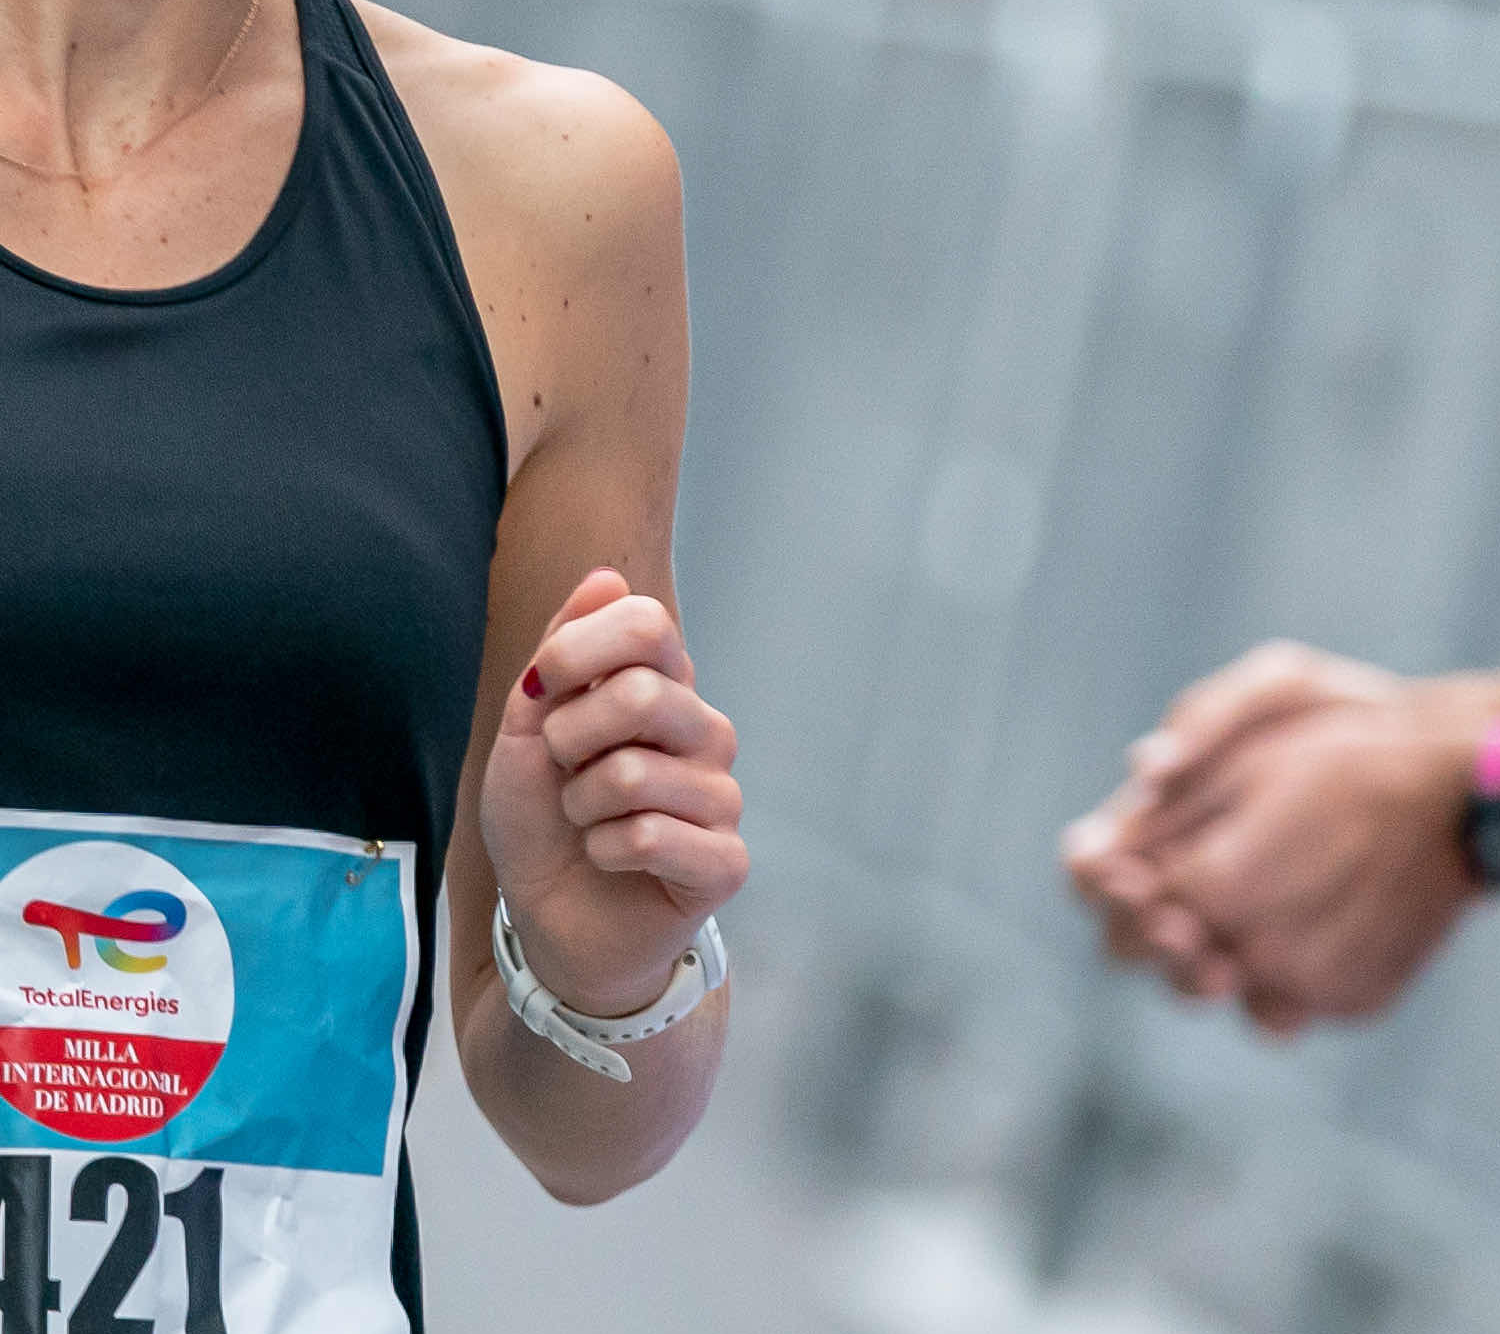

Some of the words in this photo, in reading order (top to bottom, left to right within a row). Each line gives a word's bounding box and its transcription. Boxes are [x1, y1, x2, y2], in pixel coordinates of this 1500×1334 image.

[19, 986, 180, 1018] TotalEnergies
[64, 1037, 140, 1064] MILLA
[34, 1090, 68, 1112] DE
[74, 1094, 164, 1118] MADRID
